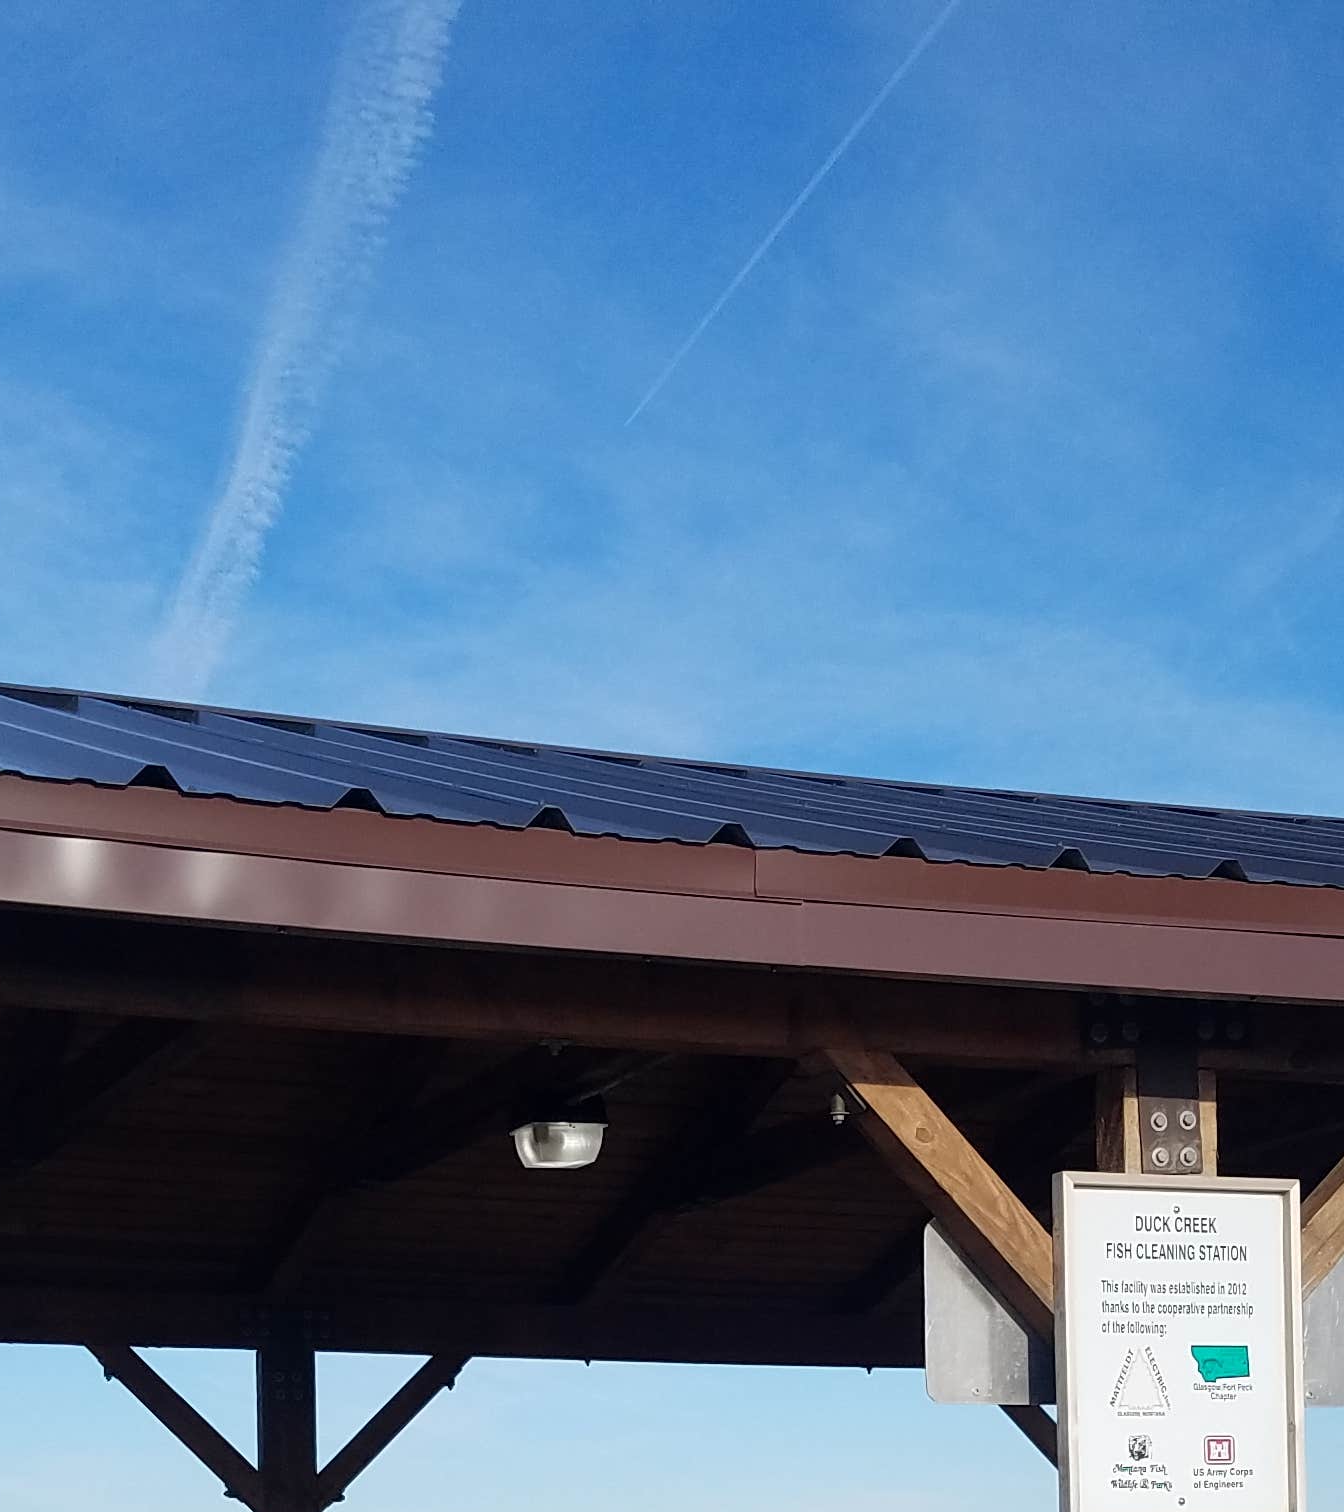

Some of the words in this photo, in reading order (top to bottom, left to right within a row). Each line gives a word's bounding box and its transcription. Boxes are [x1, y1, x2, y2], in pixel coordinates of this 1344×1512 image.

[1135, 1216, 1171, 1232] DUCK
[1174, 1217, 1217, 1233] CREEK
[1106, 1243, 1132, 1259] FISH
[1136, 1244, 1195, 1260] CLEANING
[1199, 1245, 1247, 1261] STATION
[1101, 1280, 1119, 1293] This
[1121, 1281, 1148, 1297] facility
[1151, 1283, 1166, 1294] was
[1169, 1282, 1215, 1295] established
[1217, 1283, 1225, 1295] in
[1227, 1283, 1247, 1295] 2012
[1102, 1301, 1129, 1313] thanks
[1132, 1302, 1140, 1314] to
[1143, 1302, 1155, 1314] the
[1158, 1303, 1205, 1317] cooperative
[1208, 1303, 1253, 1318] partnership
[1102, 1321, 1111, 1334] of
[1113, 1321, 1125, 1334] the
[1127, 1322, 1167, 1337] following:
[1110, 1348, 1133, 1407] MATTFELDT
[1211, 1393, 1236, 1402] Chapter
[1193, 1468, 1204, 1476] US
[1207, 1469, 1227, 1478] Army
[1229, 1468, 1253, 1477] Corps
[1204, 1481, 1243, 1490] Engineers
